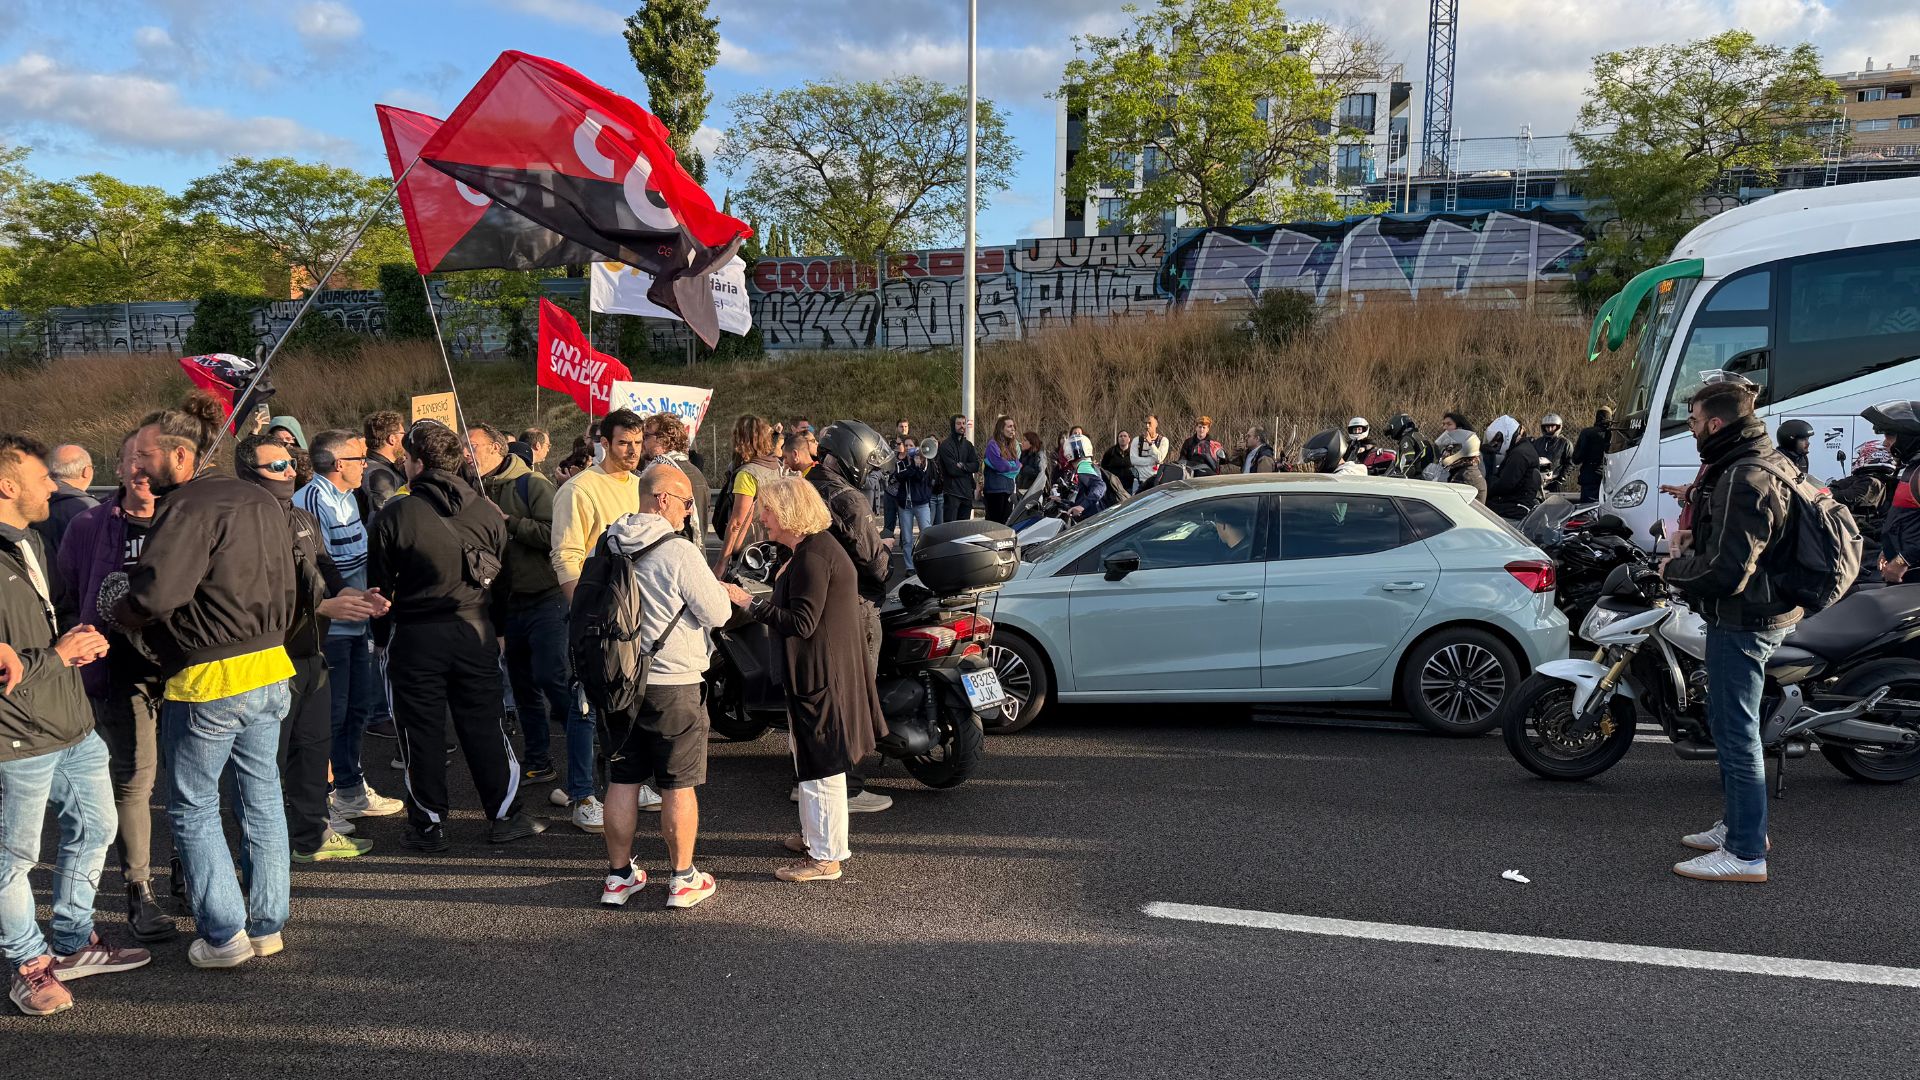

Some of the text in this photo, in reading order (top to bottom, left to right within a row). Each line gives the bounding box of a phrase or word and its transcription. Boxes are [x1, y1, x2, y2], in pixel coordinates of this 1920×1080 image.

[709, 278, 738, 296] dària
[970, 671, 997, 689] 8329
[979, 686, 998, 703] JJK
